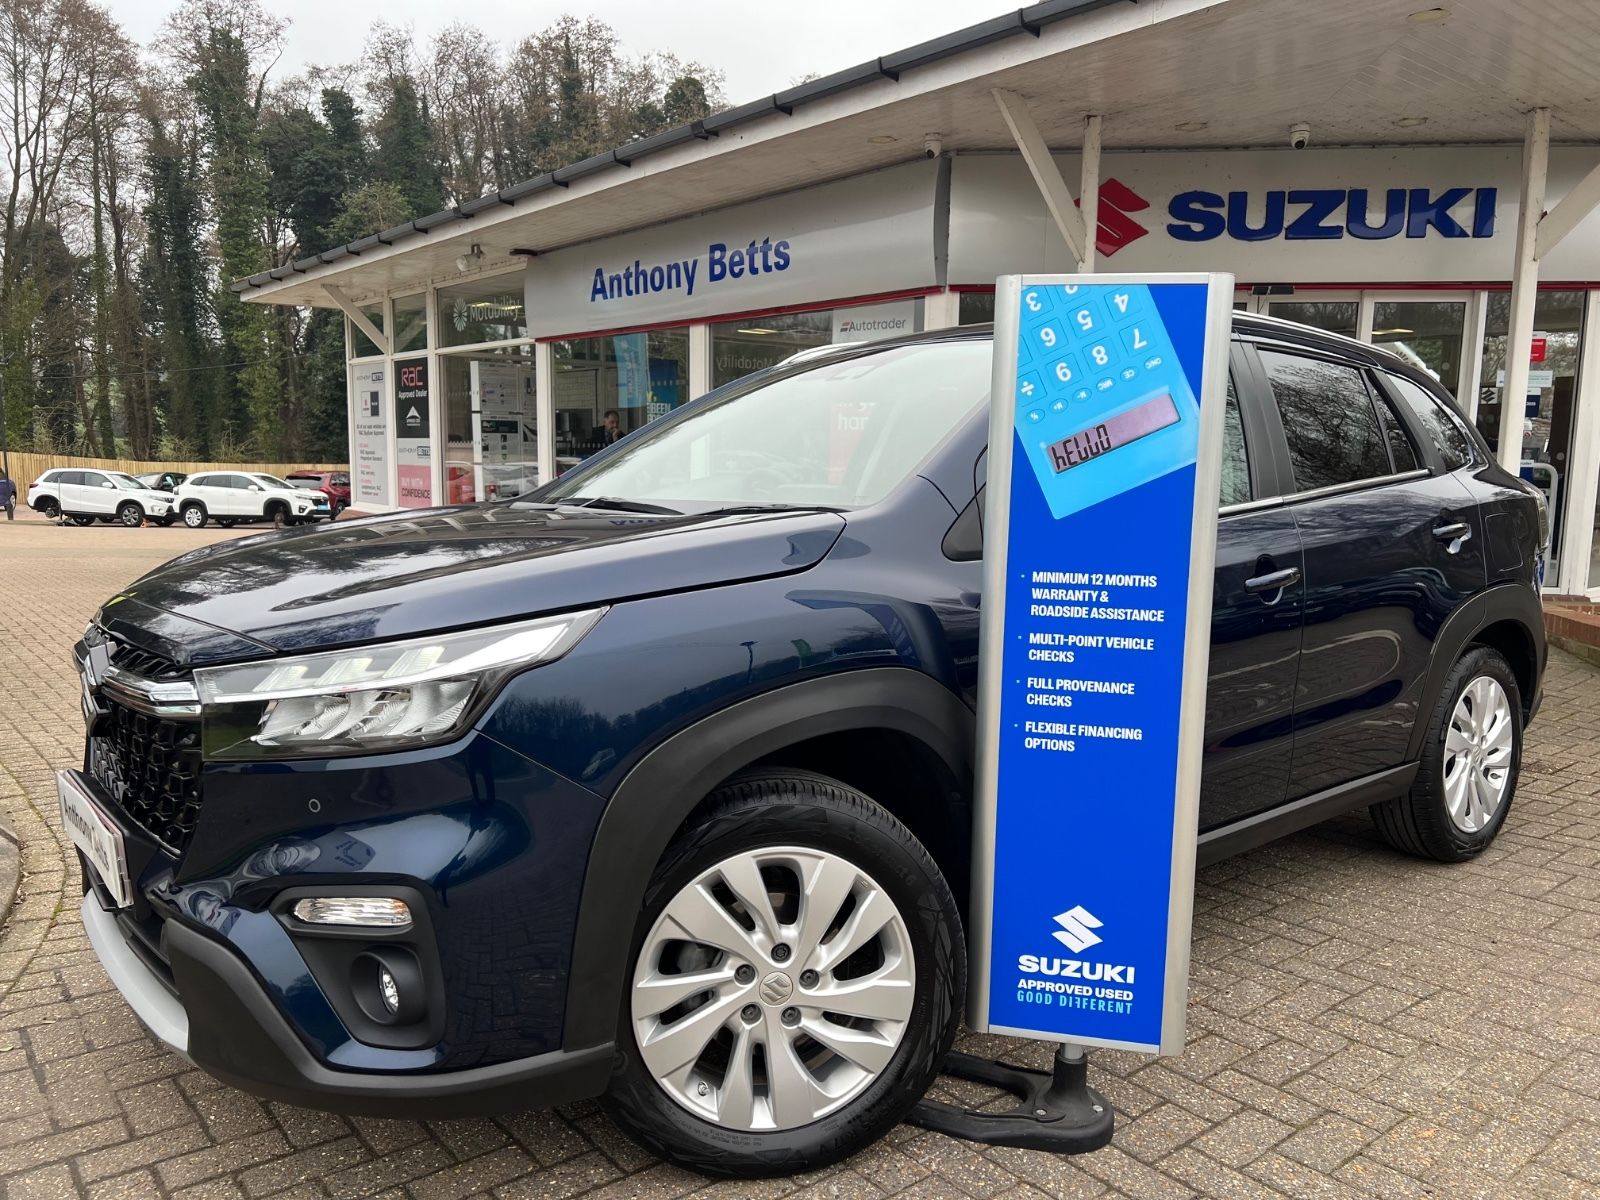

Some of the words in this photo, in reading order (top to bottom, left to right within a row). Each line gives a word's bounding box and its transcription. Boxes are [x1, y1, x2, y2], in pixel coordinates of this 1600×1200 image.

[1166, 187, 1498, 242] SUZUKI
[590, 258, 698, 302] Anthony
[709, 236, 790, 283] Betts
[1025, 292, 1042, 312] 3
[1114, 294, 1129, 314] 4
[849, 318, 906, 333] Autotrader
[1076, 310, 1094, 331] 5
[1132, 328, 1148, 350] 7
[1091, 345, 1108, 366] 8
[398, 390, 416, 400] Approved
[416, 389, 428, 398] Dealer
[402, 488, 430, 500] CONFIDENCE
[1032, 572, 1088, 584] MINIMUM
[1090, 574, 1103, 585] 12
[1105, 574, 1158, 588] MONTHS
[1032, 588, 1098, 602] WARRANTY
[1100, 590, 1110, 602] &
[1030, 604, 1089, 618] ROADSIDE
[1090, 608, 1164, 622] ASSISTANCE
[1029, 632, 1104, 648] MULTI-POINT
[1106, 637, 1154, 650] VEHICLE
[1028, 648, 1074, 662] CHECKS
[1028, 677, 1054, 690] FULL
[1056, 679, 1135, 694] PROVENANCE
[1026, 694, 1072, 708] CHECKS
[1026, 720, 1076, 736] FLEXIBLE
[1078, 724, 1142, 740] FINANCING
[1024, 737, 1076, 752] OPTIONS
[1018, 954, 1136, 984] SUZUKI
[1018, 978, 1093, 996] APPROVED
[1095, 988, 1134, 1001] USED
[1017, 990, 1052, 1005] GOOD
[1060, 996, 1133, 1015] DIFFERENT
